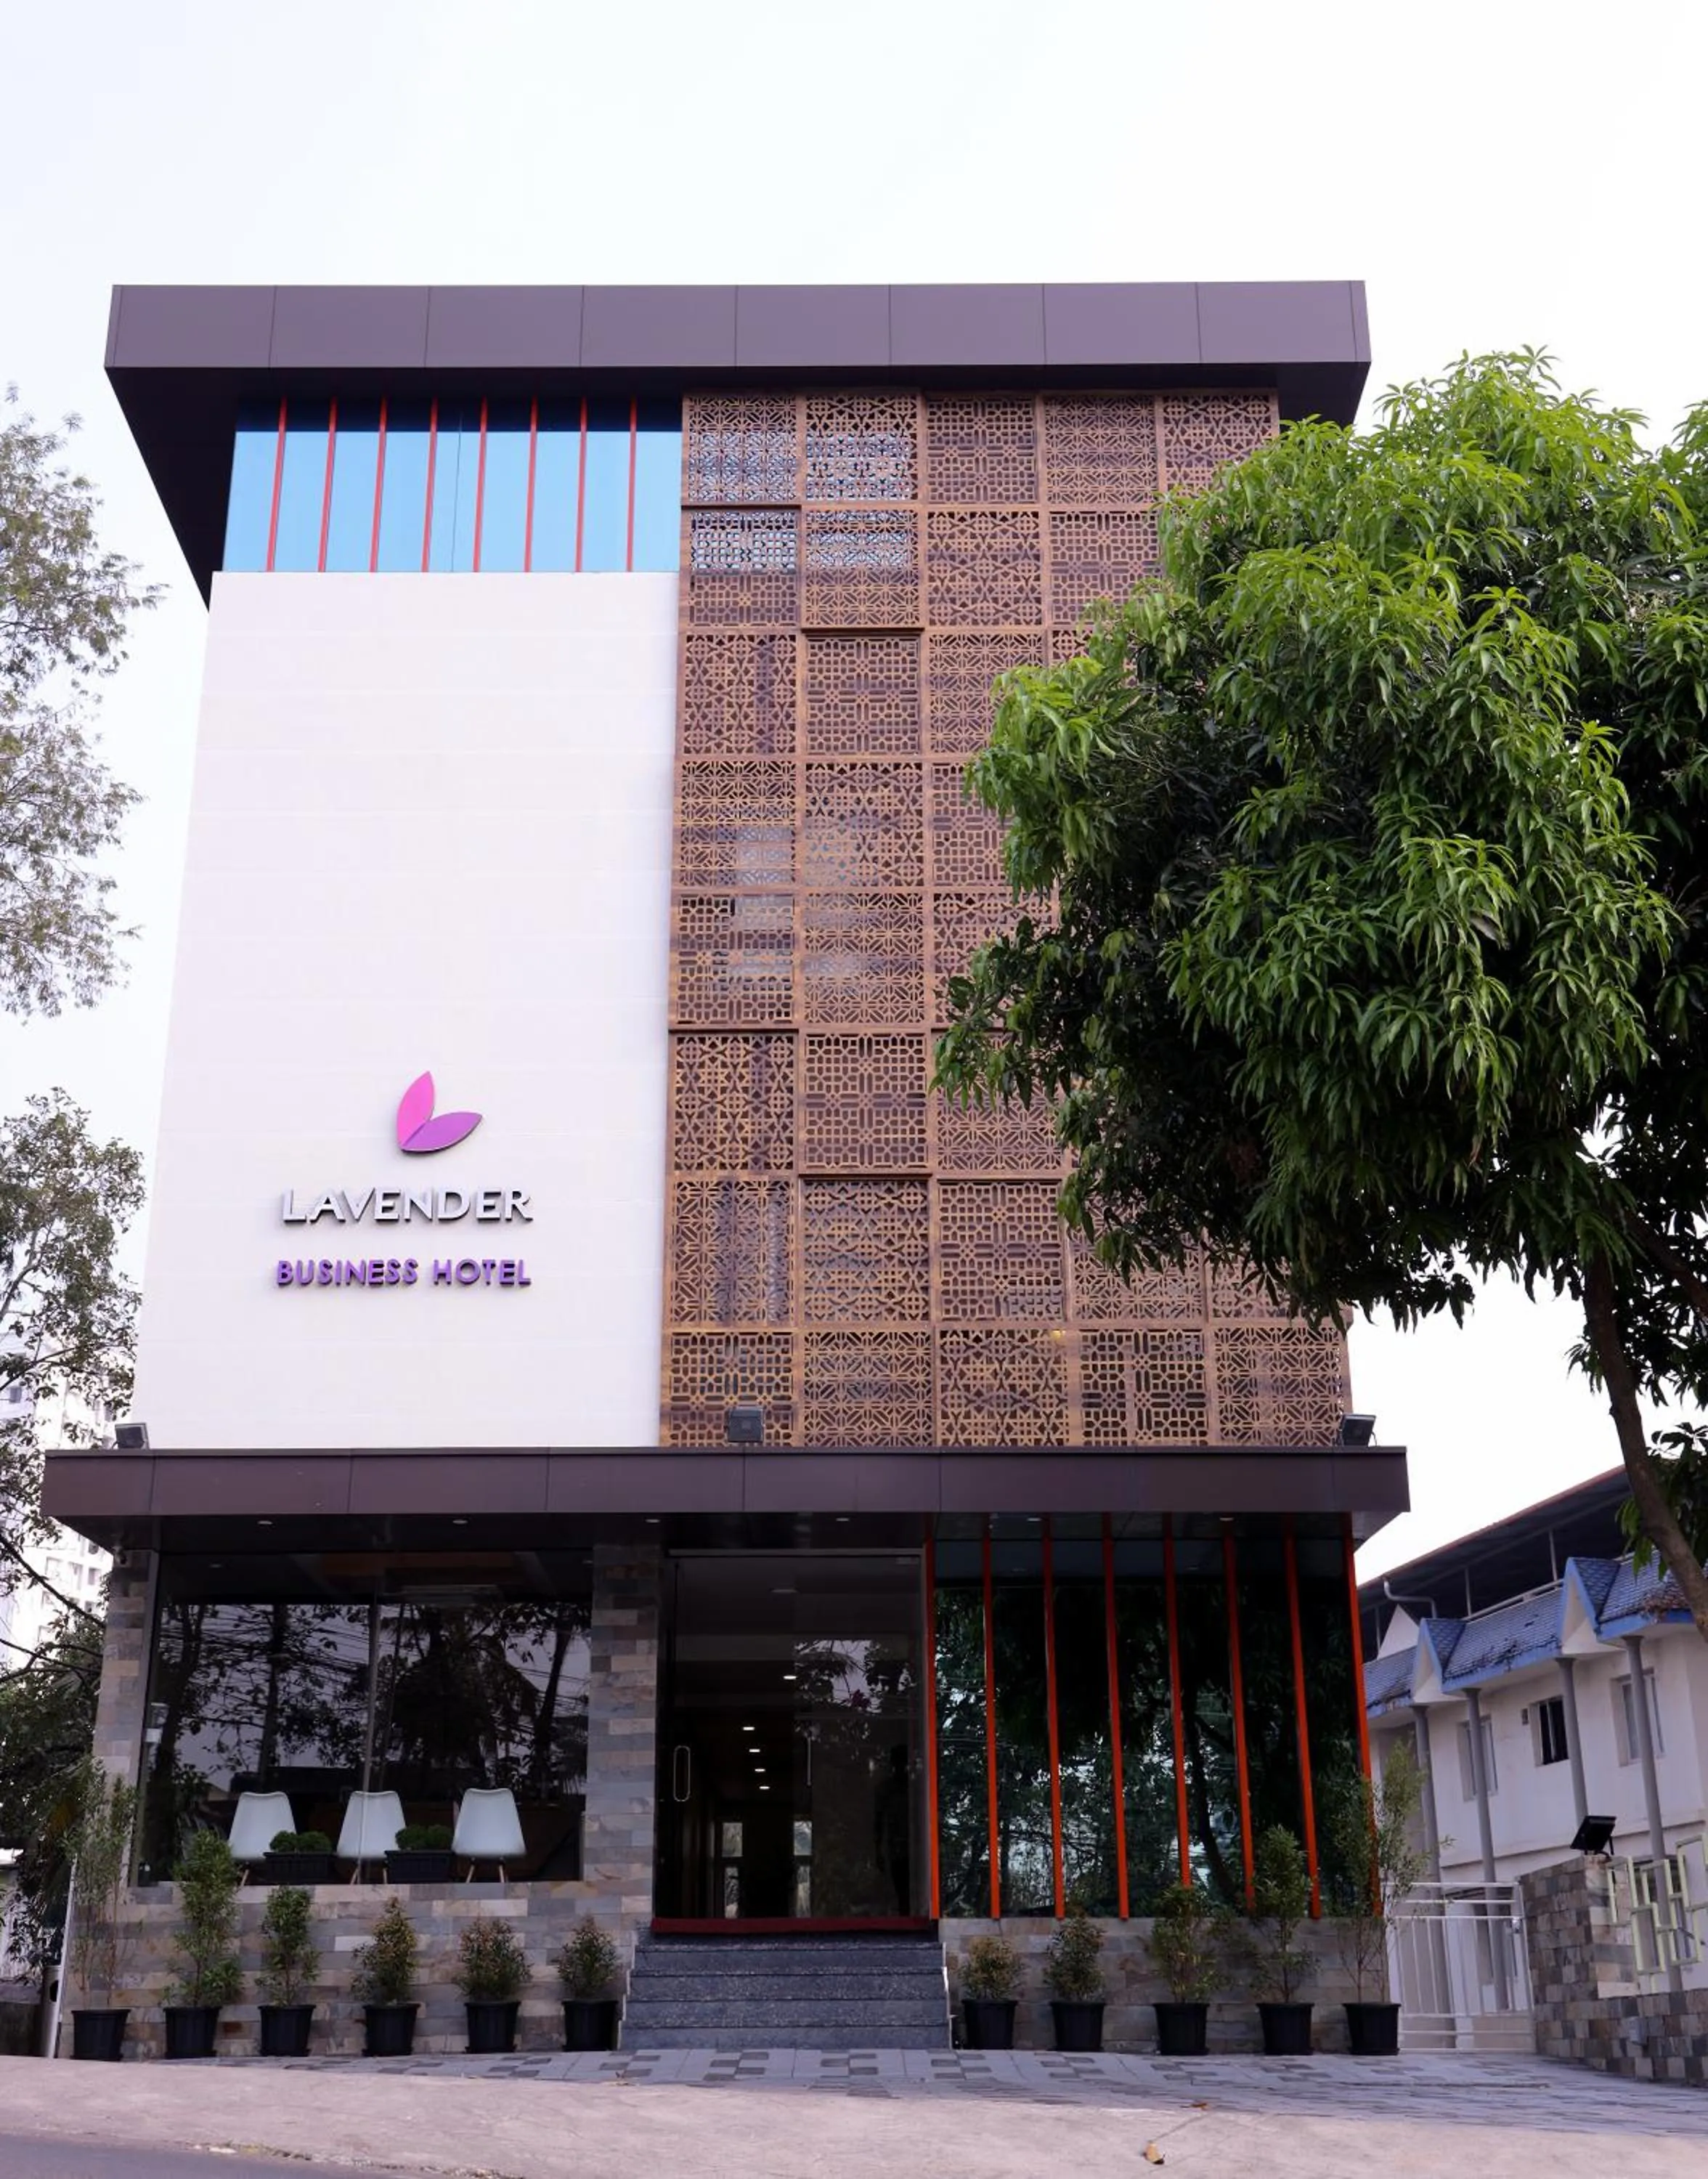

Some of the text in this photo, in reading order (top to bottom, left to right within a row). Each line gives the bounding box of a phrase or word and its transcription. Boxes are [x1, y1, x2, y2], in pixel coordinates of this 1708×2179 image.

[282, 1188, 534, 1223] LAVENDER
[277, 1259, 532, 1286] BUSINESS HOTEL
